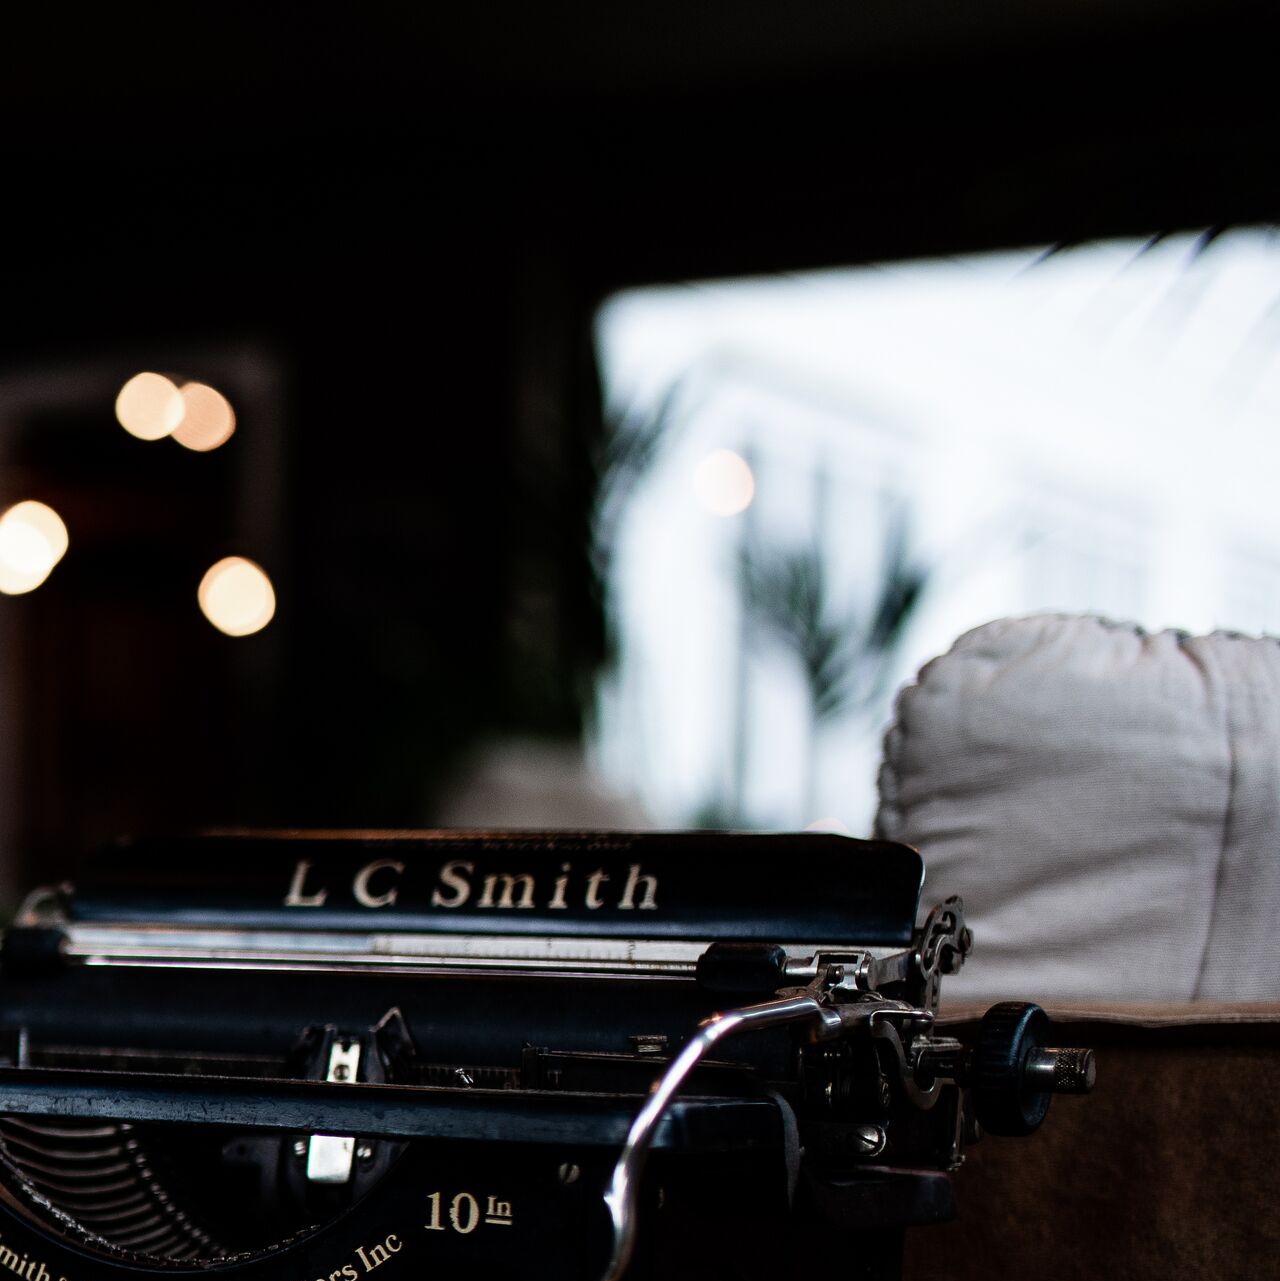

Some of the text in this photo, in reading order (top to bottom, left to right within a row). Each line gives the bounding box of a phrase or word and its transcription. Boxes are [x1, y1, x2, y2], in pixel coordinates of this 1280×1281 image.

[283, 857, 659, 911] L C Smith
[354, 1231, 404, 1274] Inc
